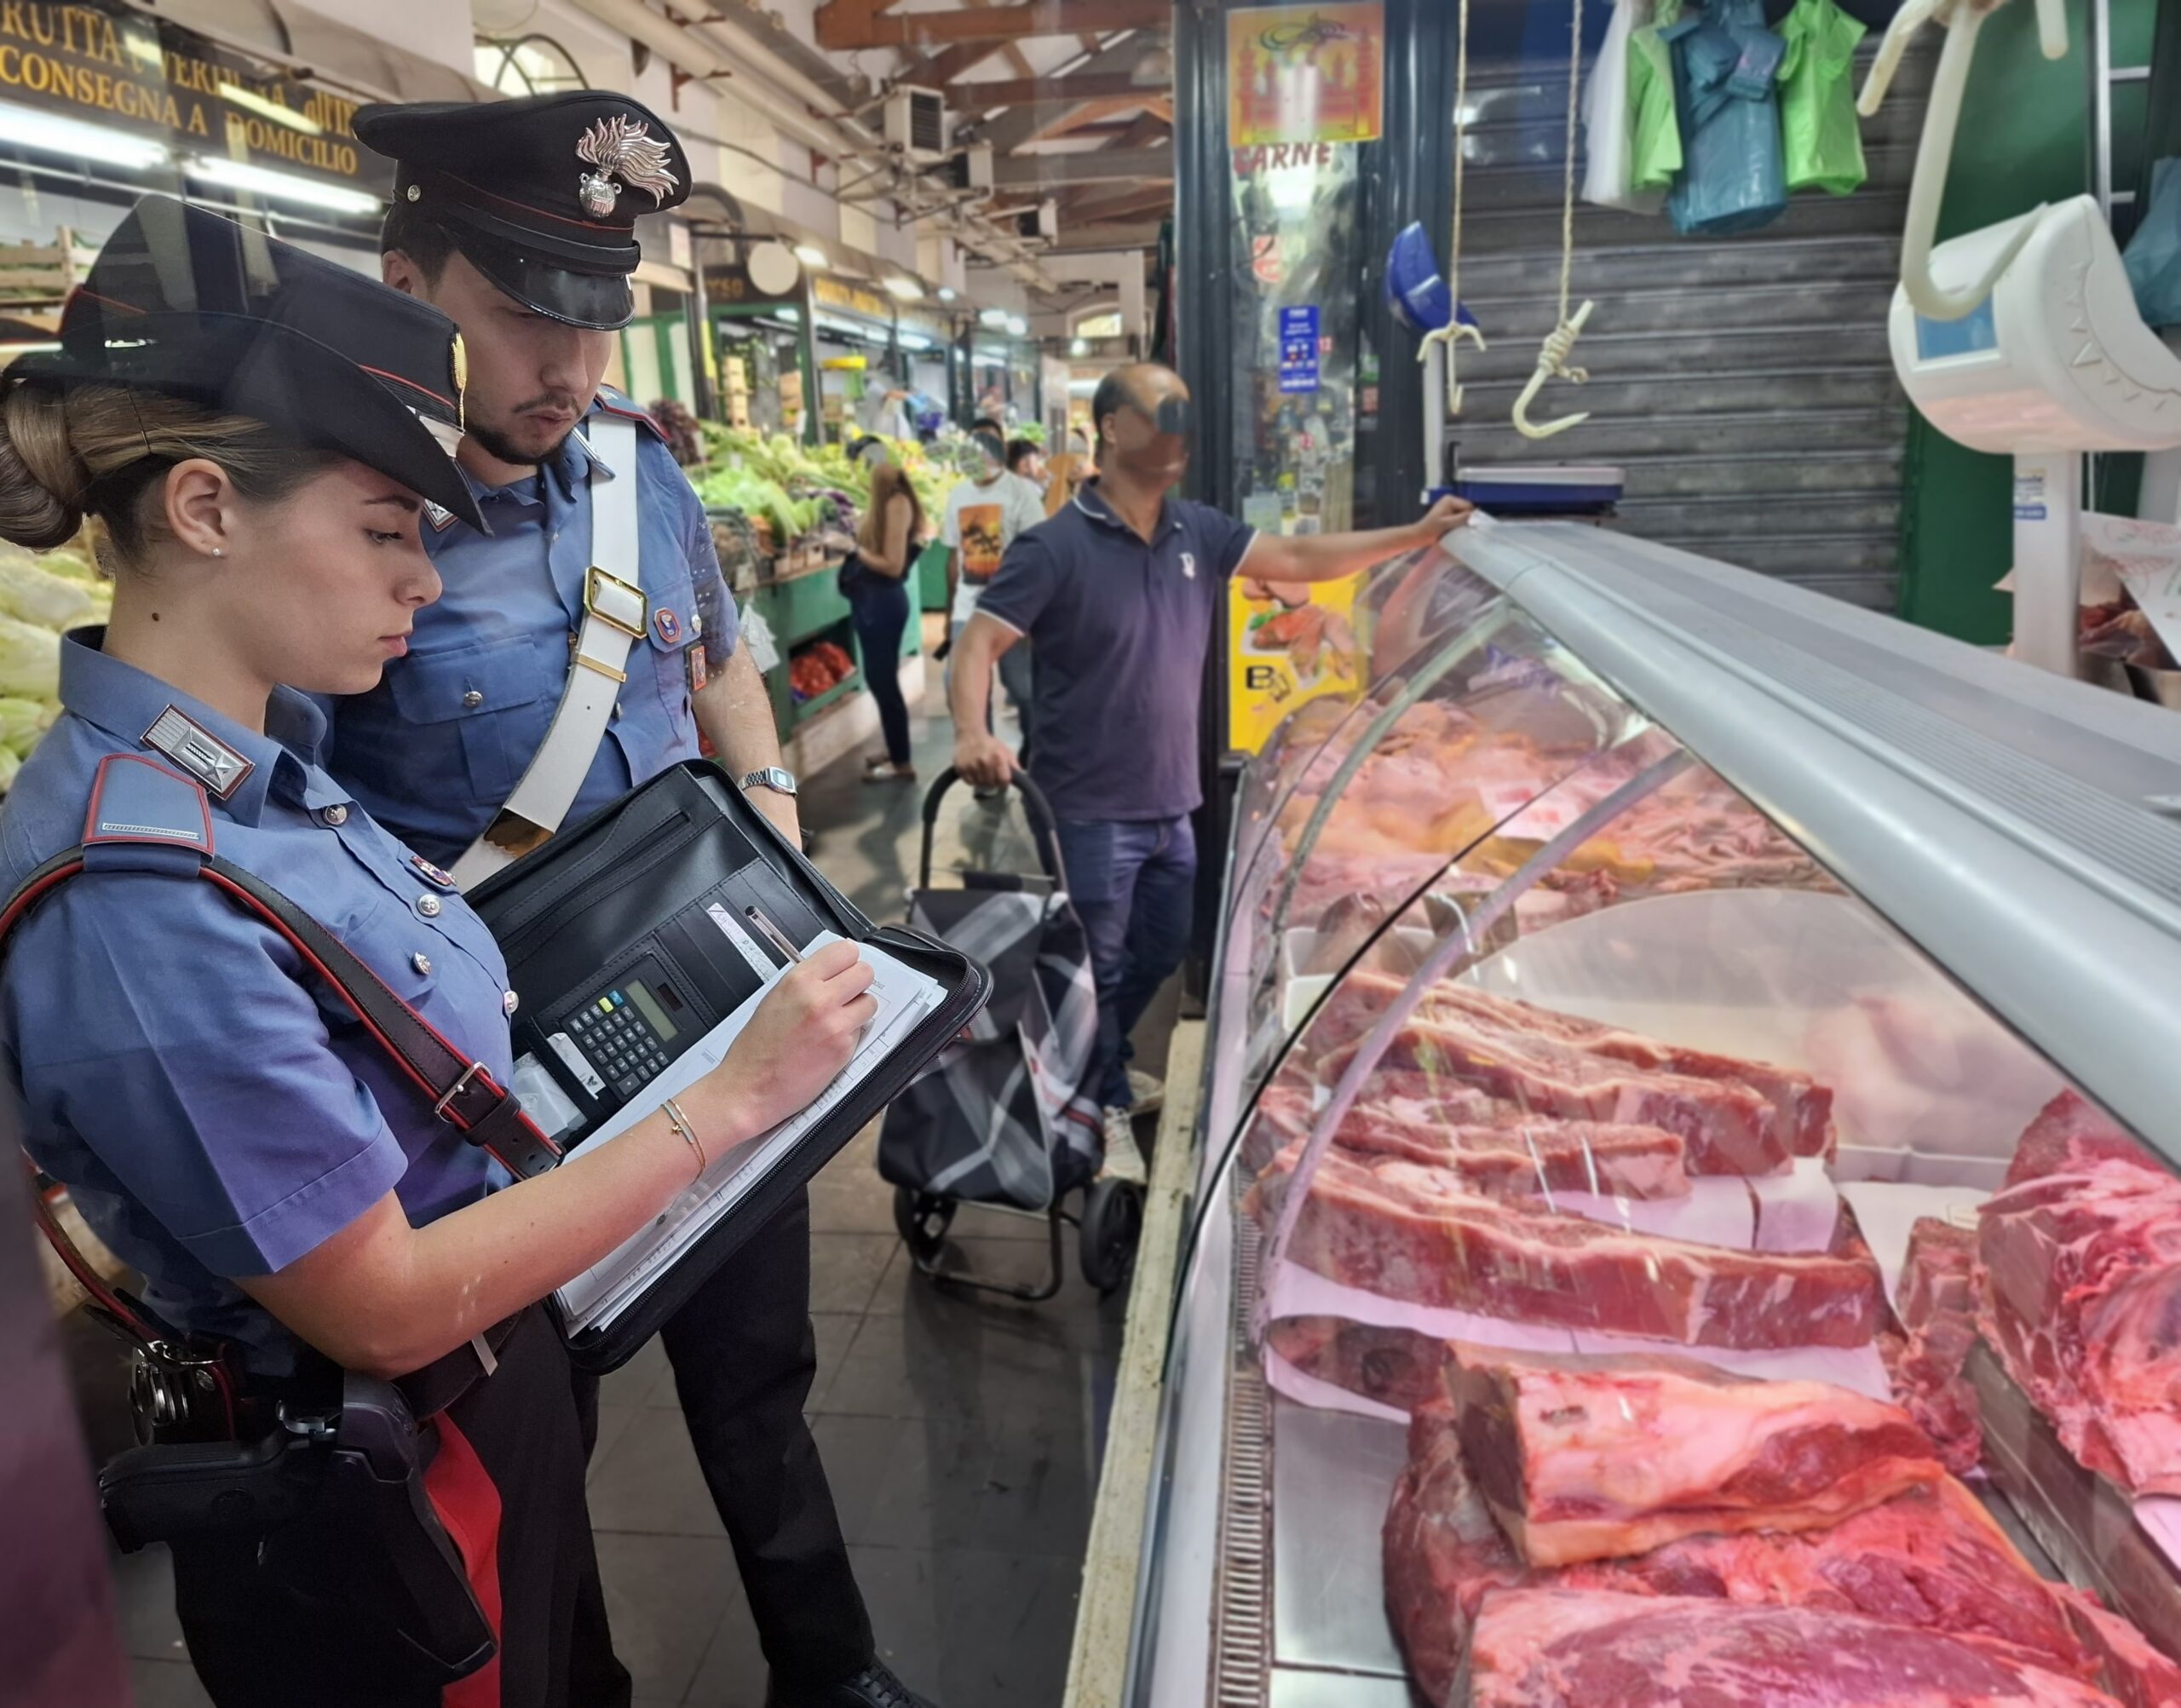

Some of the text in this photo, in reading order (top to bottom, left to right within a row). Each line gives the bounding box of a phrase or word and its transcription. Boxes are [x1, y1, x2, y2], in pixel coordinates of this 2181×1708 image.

[0, 45, 182, 129] CONSEGNA
[188, 103, 209, 136] A
[226, 112, 358, 175] DOMICILIO
